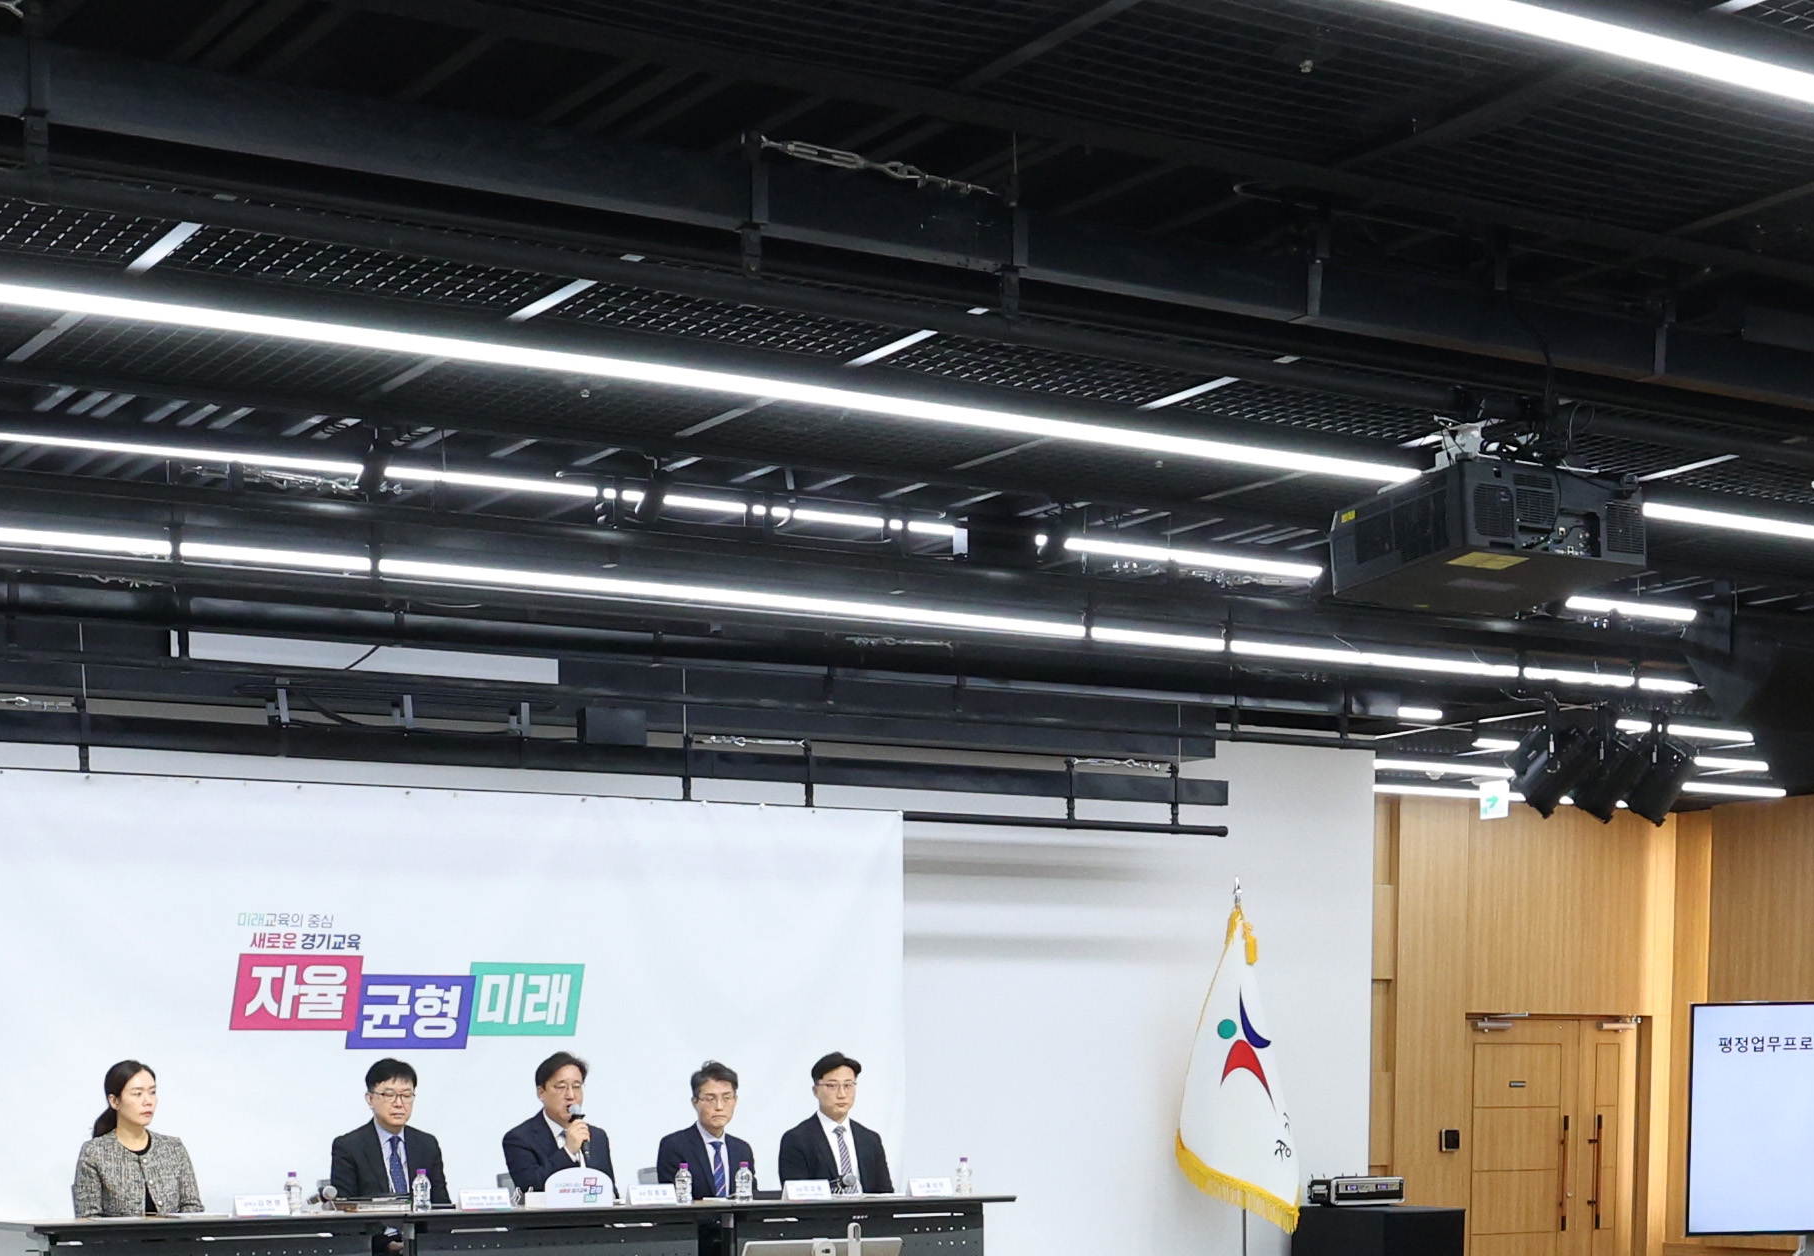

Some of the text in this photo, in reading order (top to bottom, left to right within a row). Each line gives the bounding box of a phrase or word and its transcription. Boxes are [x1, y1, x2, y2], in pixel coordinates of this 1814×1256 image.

[237, 913, 334, 928] 미래교육의 중심
[250, 932, 361, 950] 새로운 경기교육
[244, 964, 572, 1040] 자율 균형 미래
